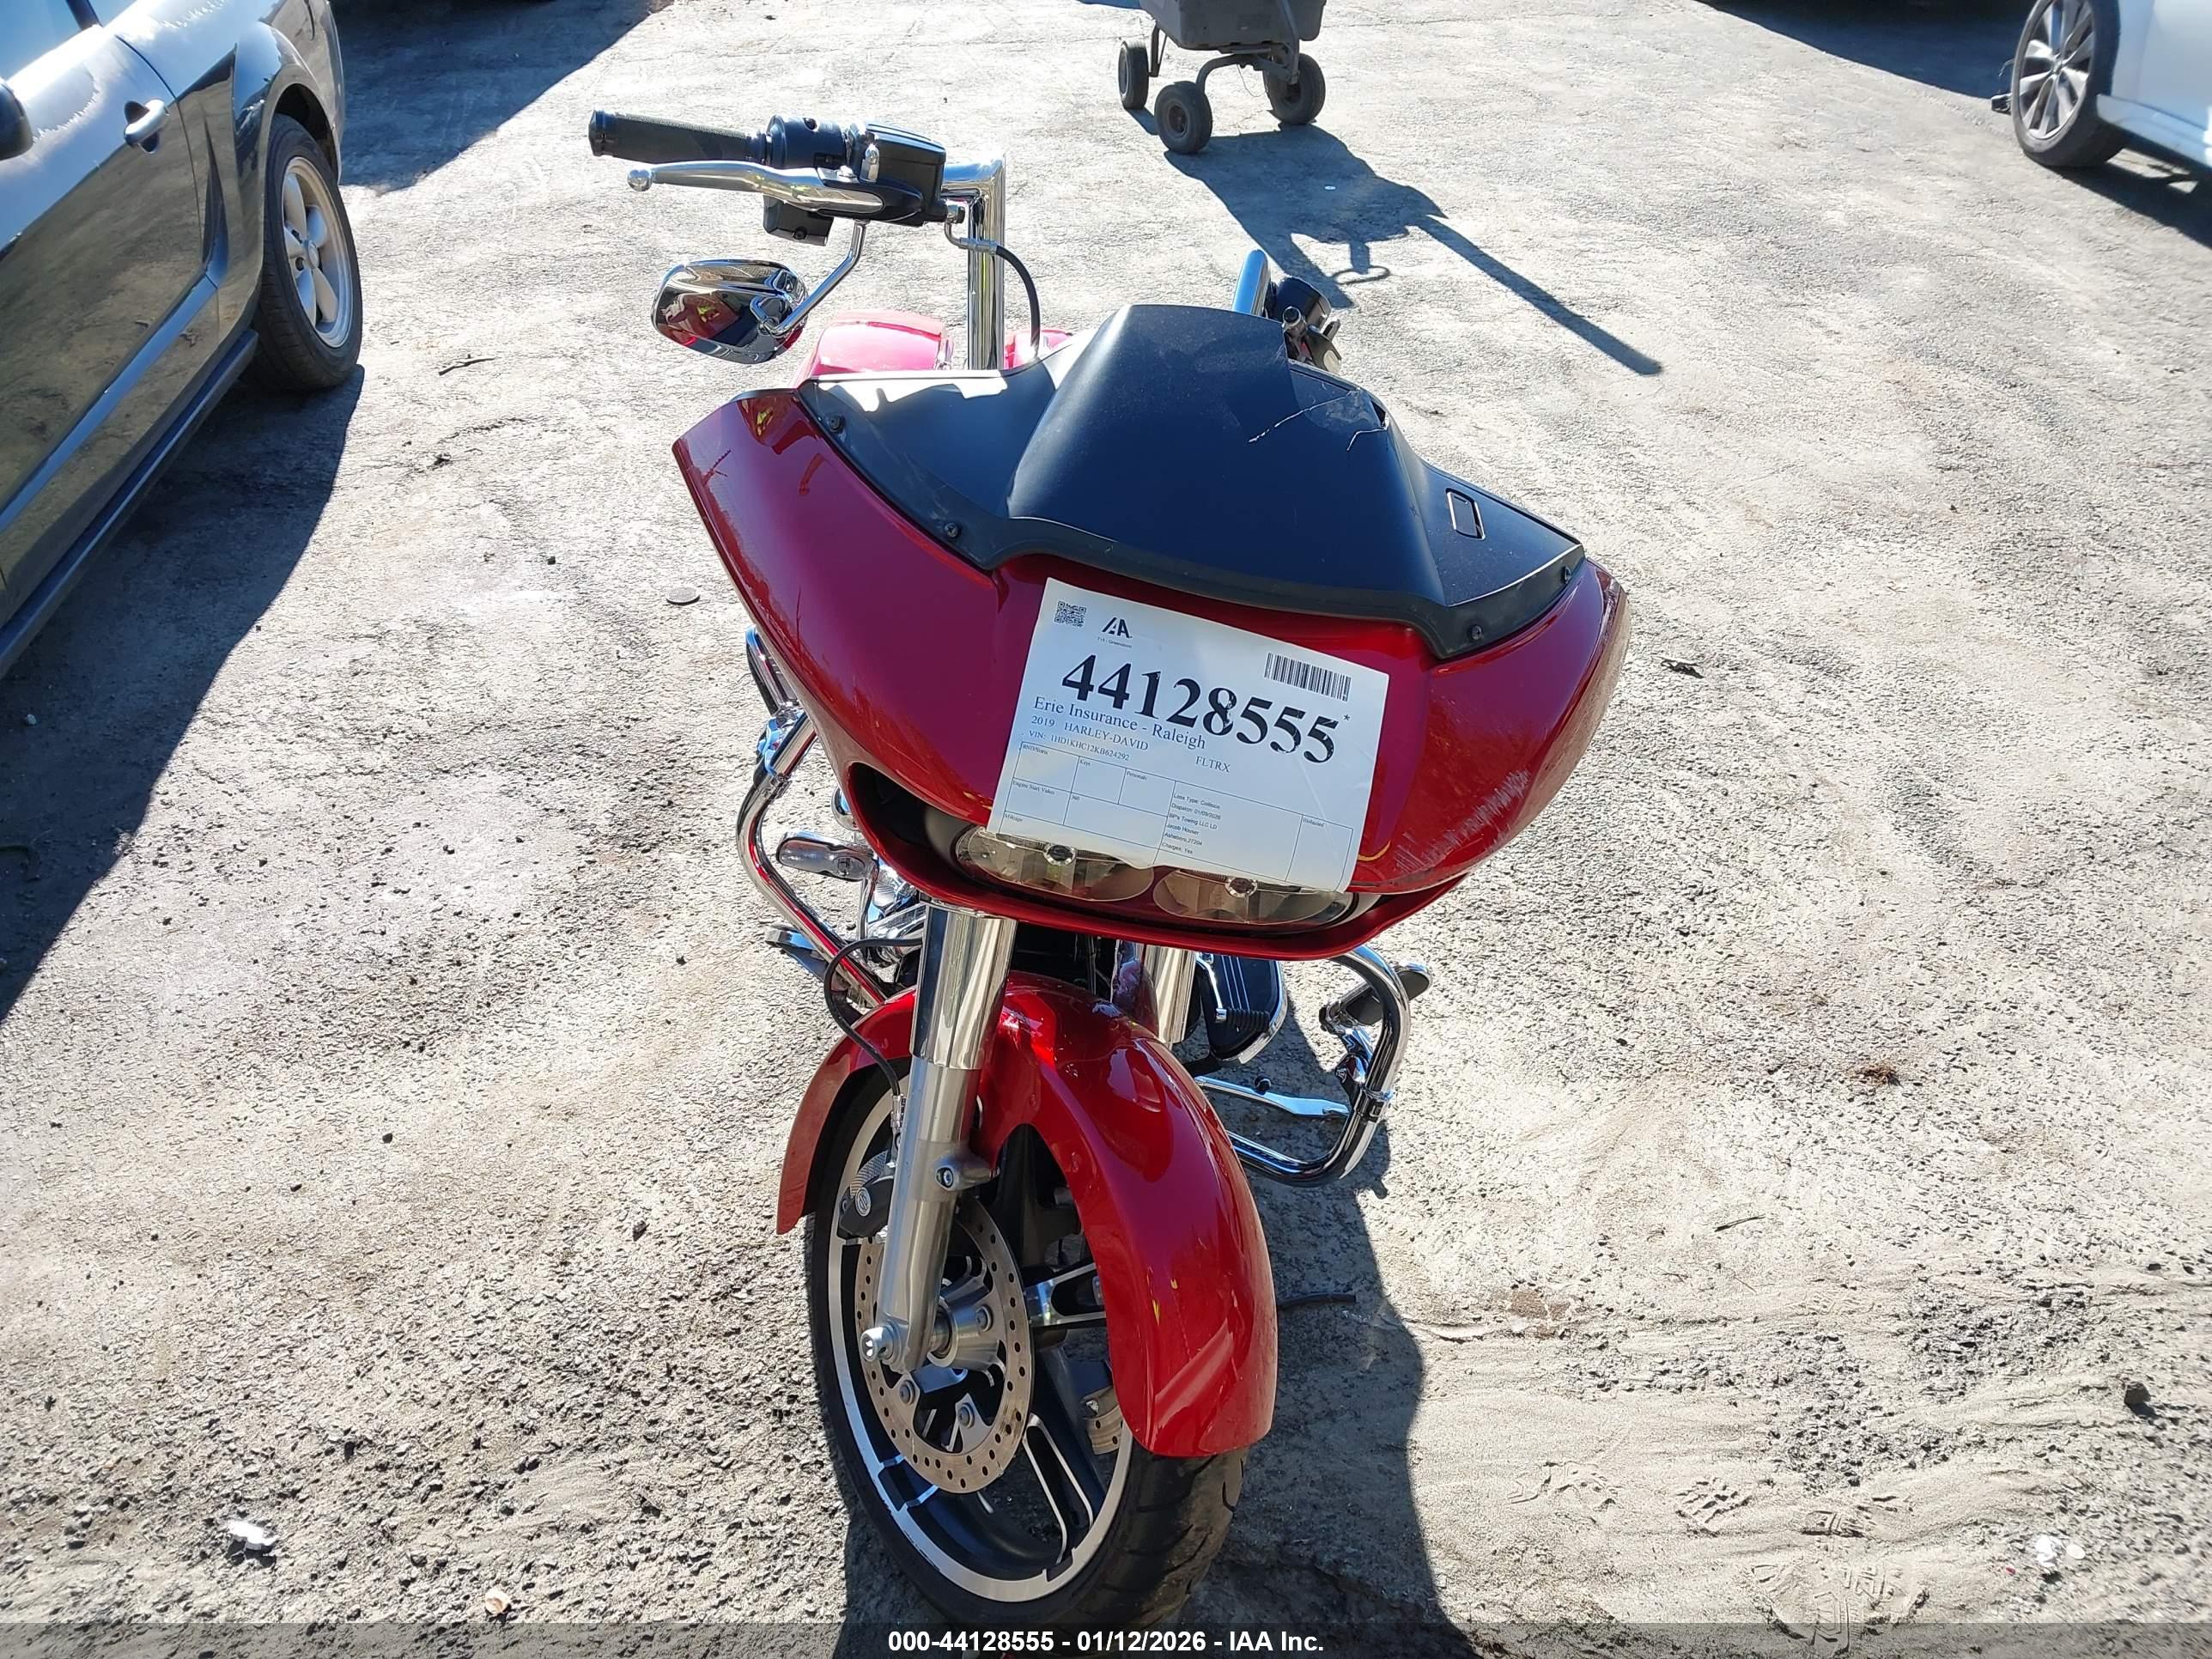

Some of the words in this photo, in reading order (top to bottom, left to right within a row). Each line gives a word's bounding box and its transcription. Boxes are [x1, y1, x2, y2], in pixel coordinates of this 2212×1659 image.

[1029, 730, 1047, 740] VIN:
[1034, 696, 1064, 714] Erie
[1069, 703, 1139, 731] Insurance
[1152, 723, 1206, 750] Raleigh
[1061, 653, 1340, 763] 44128555
[1030, 715, 1055, 727] 2019
[1064, 722, 1149, 750] HARLEY-DAVID
[1195, 756, 1231, 772] FLTRX
